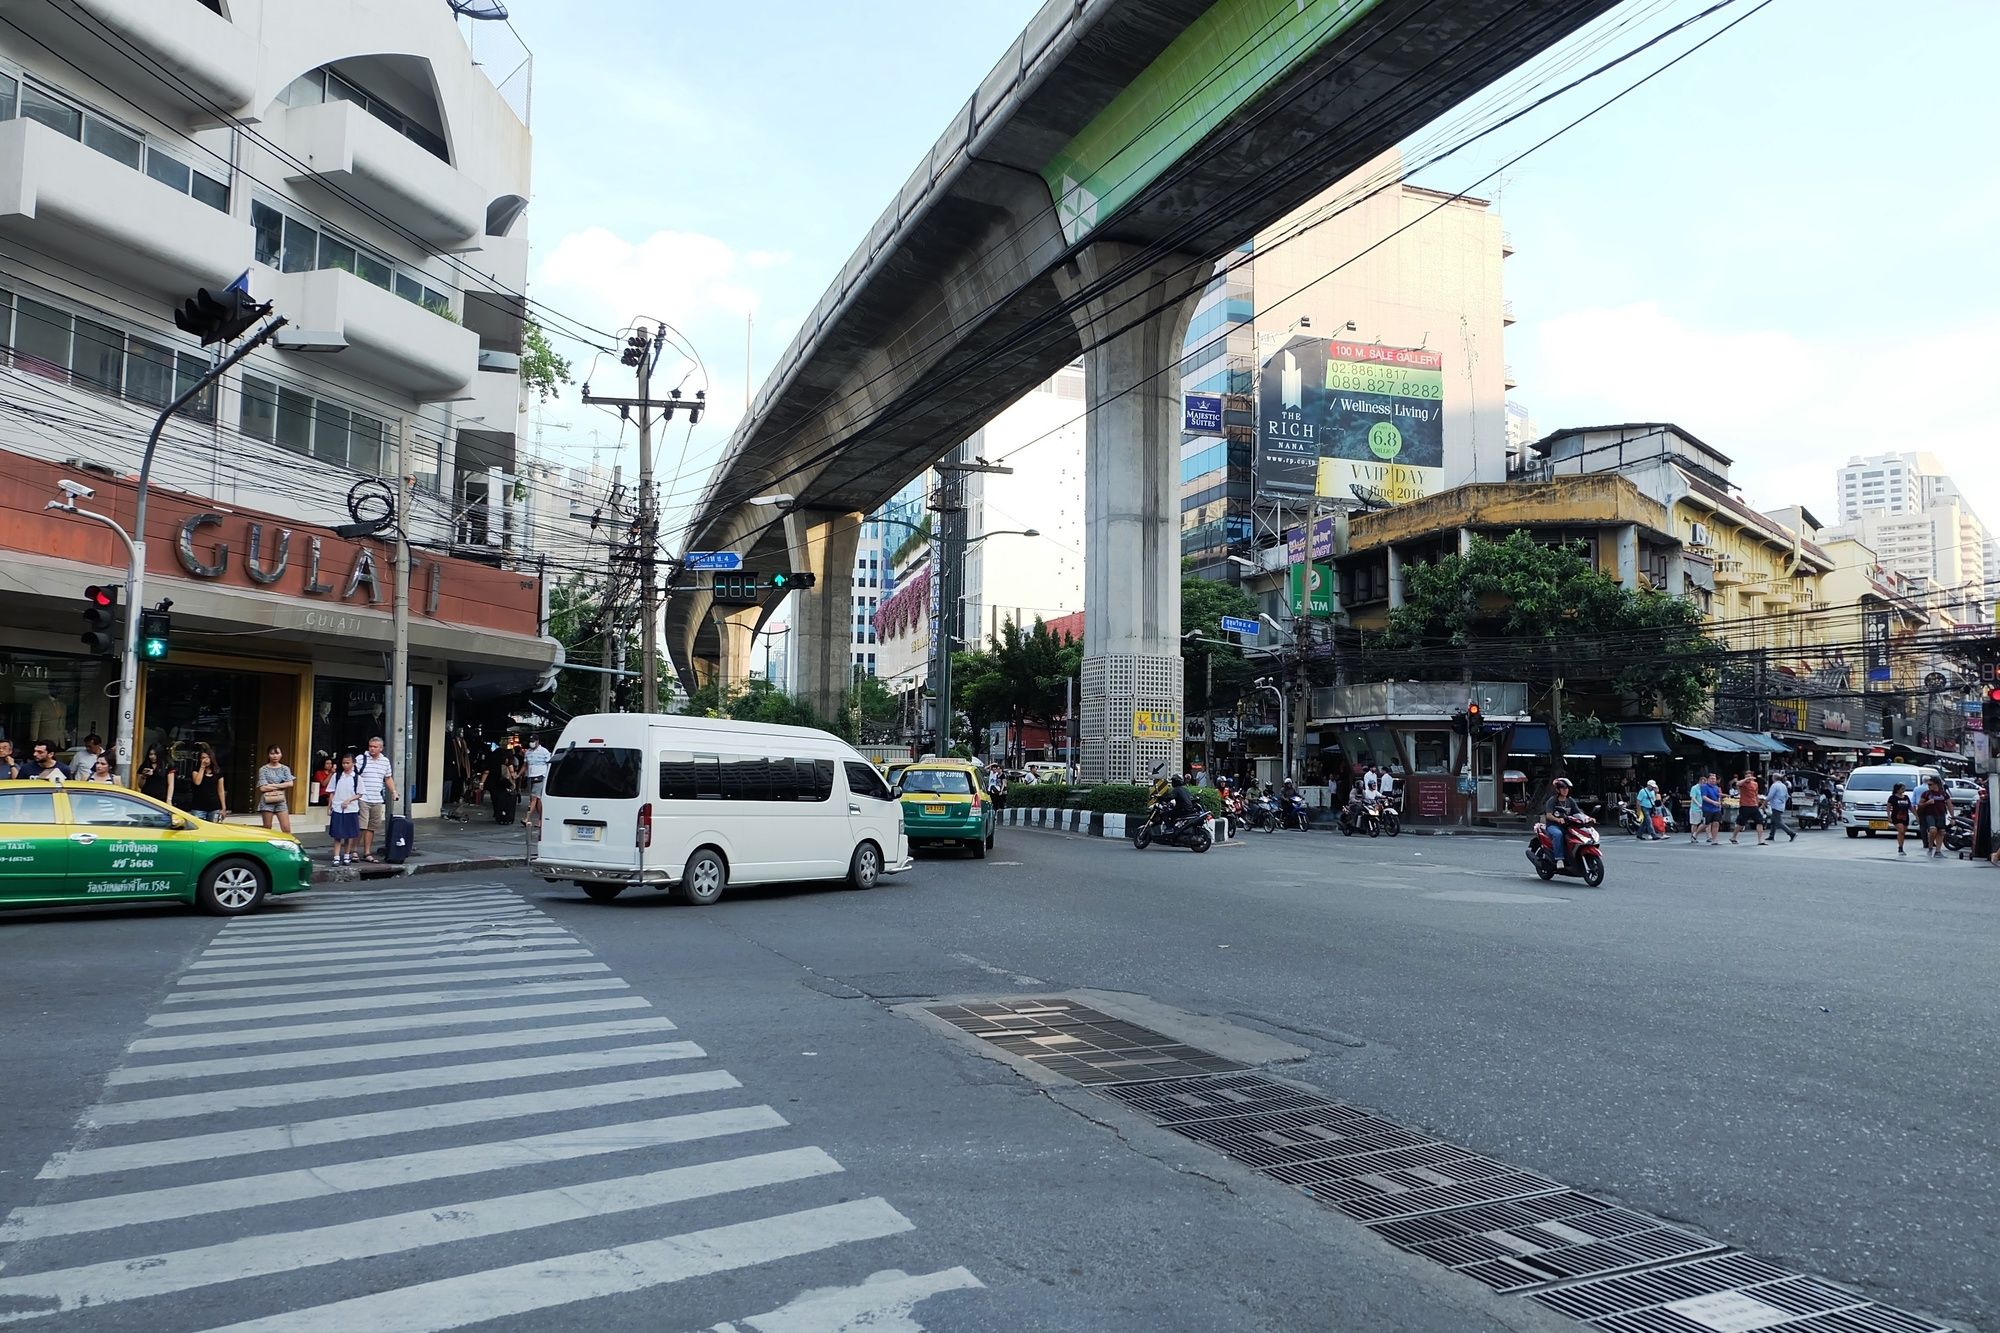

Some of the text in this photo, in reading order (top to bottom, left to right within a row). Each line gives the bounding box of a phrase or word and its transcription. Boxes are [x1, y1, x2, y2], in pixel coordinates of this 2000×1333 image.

[1336, 346, 1440, 366] 100 M. SALE GALLERY
[1331, 362, 1409, 380] 02.886.1817
[1331, 374, 1440, 399] 089.827.8282
[1281, 411, 1302, 421] THE
[1340, 398, 1391, 416] Wellness
[1395, 404, 1429, 421] Living
[1268, 421, 1314, 438] RICH
[1278, 441, 1304, 451] NANA
[1373, 430, 1398, 448] 6.8
[1395, 469, 1428, 486] DAY
[1397, 487, 1424, 500] 2016
[306, 611, 361, 631] GULATI
[7, 842, 25, 850] TAXI
